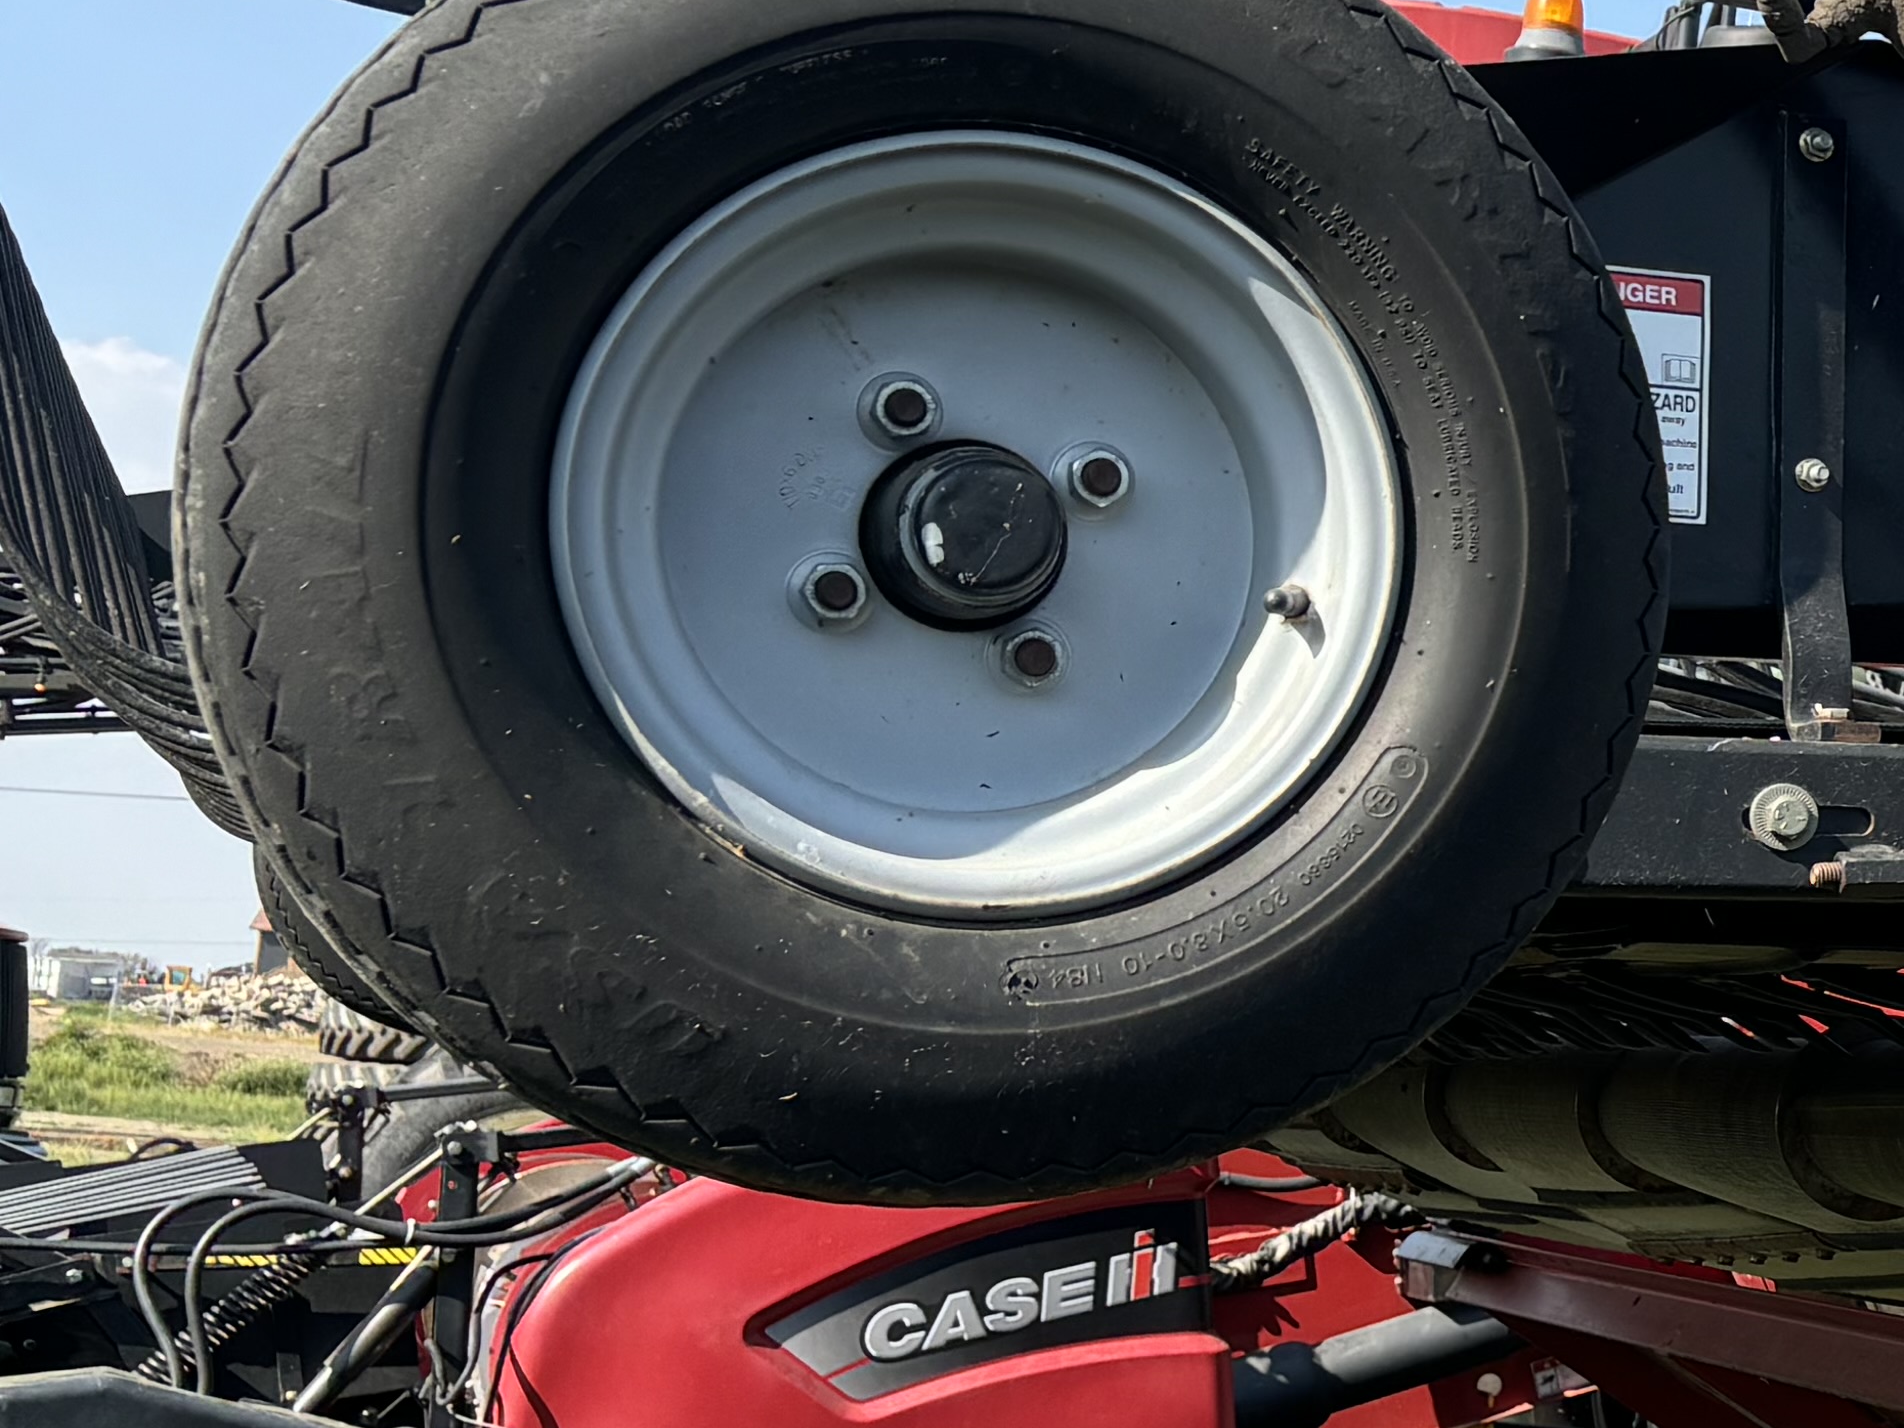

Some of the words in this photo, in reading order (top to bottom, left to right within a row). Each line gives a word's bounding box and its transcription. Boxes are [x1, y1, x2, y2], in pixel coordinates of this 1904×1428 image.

[1246, 138, 1321, 192] SAFETY
[1617, 282, 1676, 305] GER
[1652, 393, 1696, 412] ZARD
[1661, 438, 1697, 448] achine
[863, 1261, 1097, 1360] CASE
